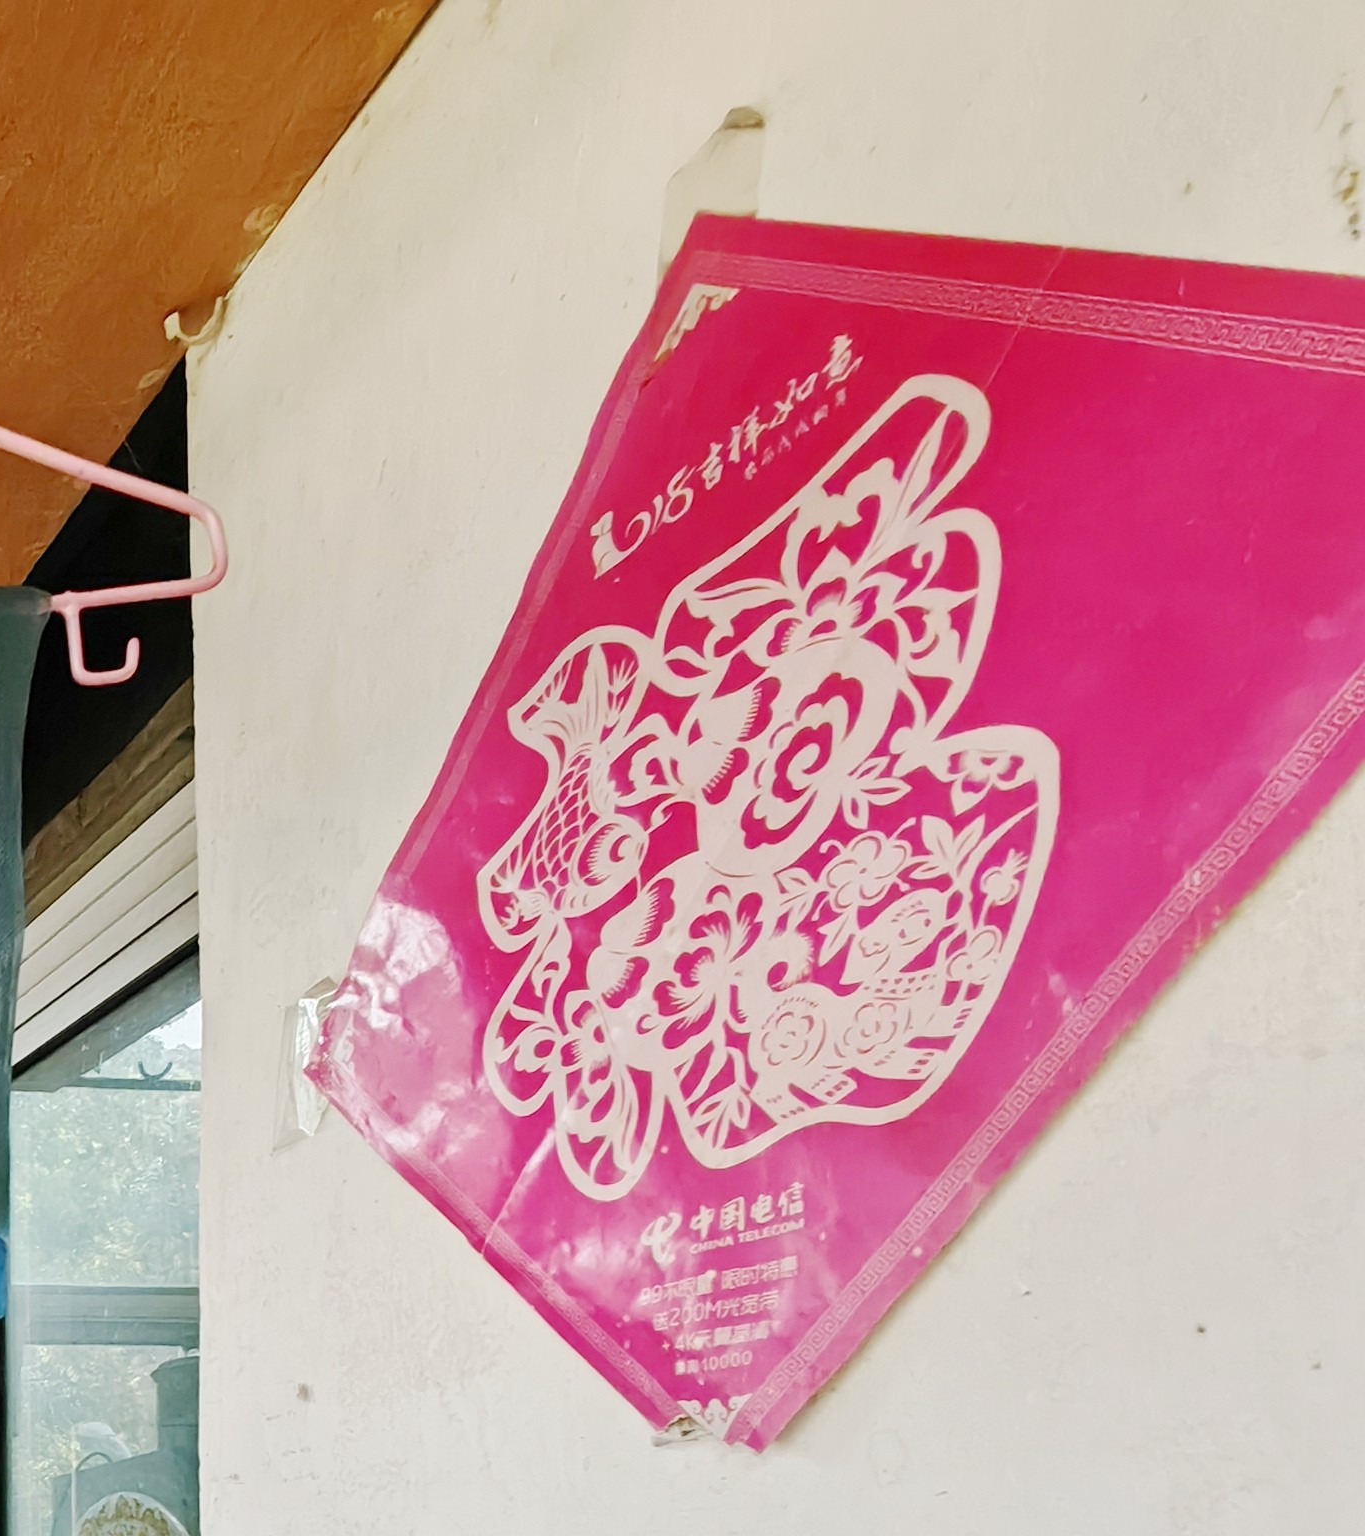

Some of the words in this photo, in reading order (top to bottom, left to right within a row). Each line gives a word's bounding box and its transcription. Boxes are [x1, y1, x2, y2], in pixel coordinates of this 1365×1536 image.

[689, 1181, 805, 1240] 中国电信
[689, 1235, 734, 1255] CHINA
[737, 1218, 806, 1244] TELECOM
